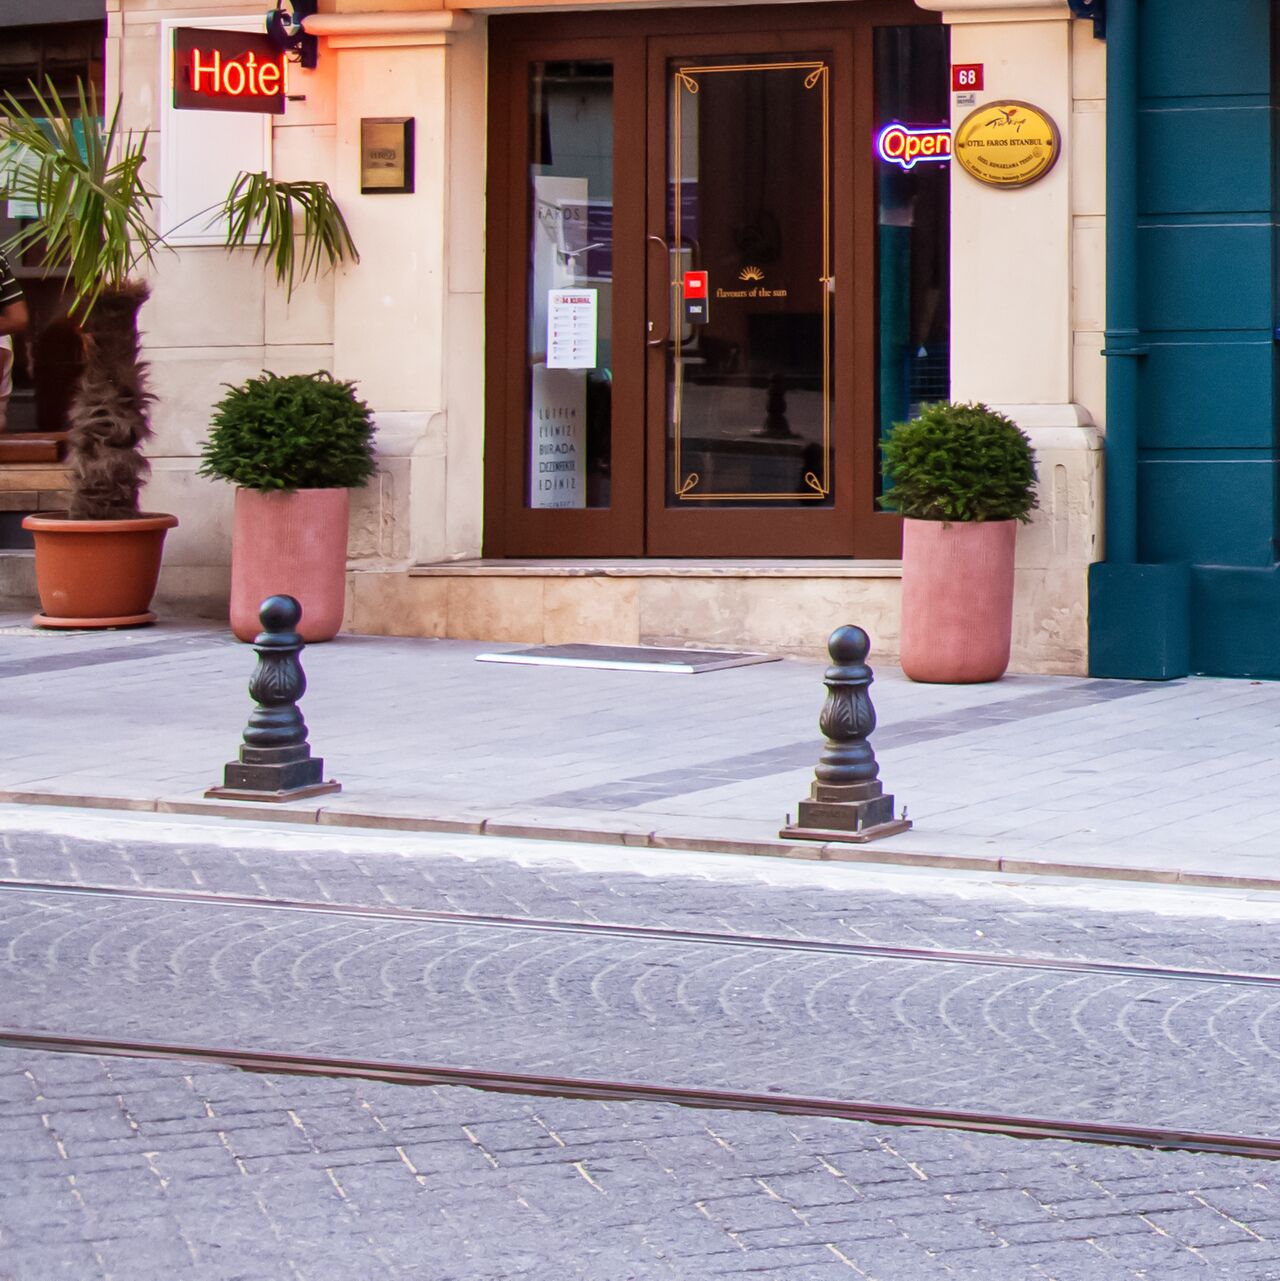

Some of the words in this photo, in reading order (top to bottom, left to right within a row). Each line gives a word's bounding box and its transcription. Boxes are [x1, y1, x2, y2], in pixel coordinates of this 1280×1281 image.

[193, 48, 289, 95] Hotel
[959, 69, 976, 85] 68
[885, 131, 950, 161] Open
[986, 139, 1008, 147] FAROS
[716, 288, 747, 297] flavours
[748, 287, 757, 297] of
[758, 287, 772, 297] the
[773, 289, 787, 297] sun
